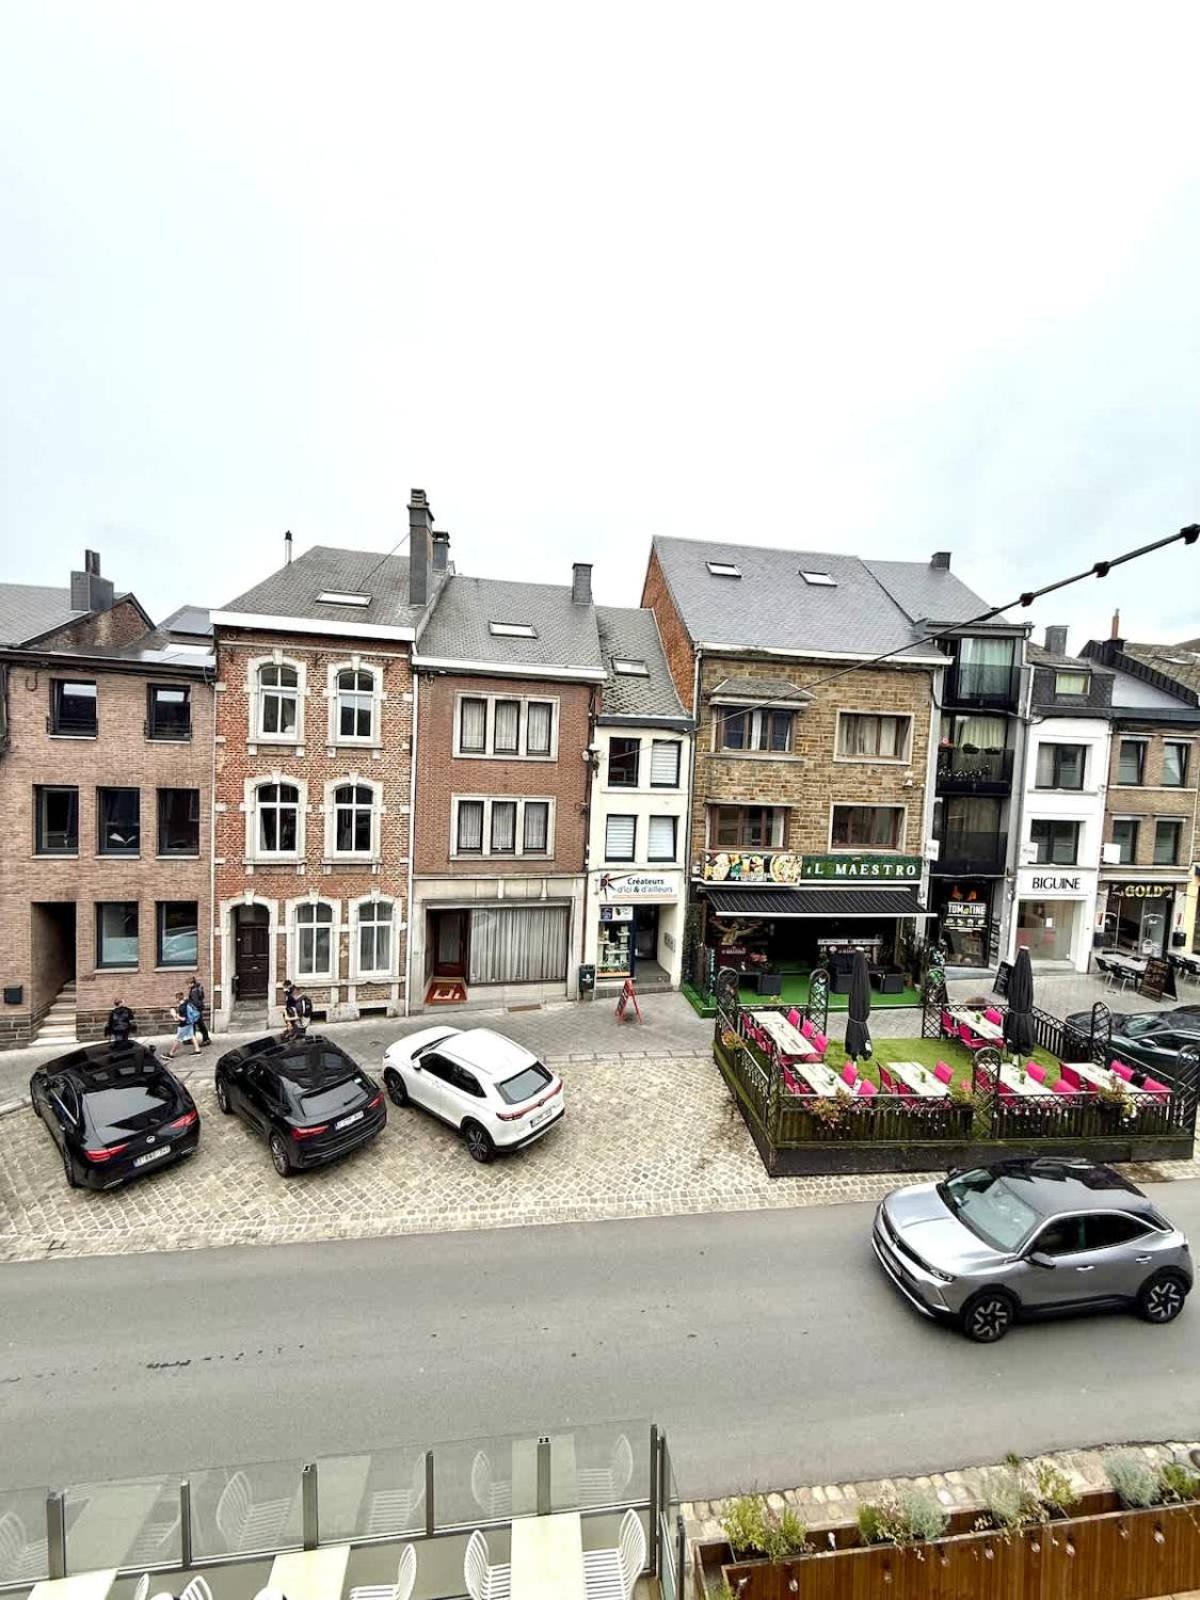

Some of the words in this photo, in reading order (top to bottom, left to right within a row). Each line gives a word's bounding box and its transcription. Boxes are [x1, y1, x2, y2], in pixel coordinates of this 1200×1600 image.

[835, 863, 916, 876] MAESTRO
[627, 877, 664, 886] Créateurs
[1031, 877, 1081, 890] BIGUINE
[1124, 884, 1164, 898] GOLD
